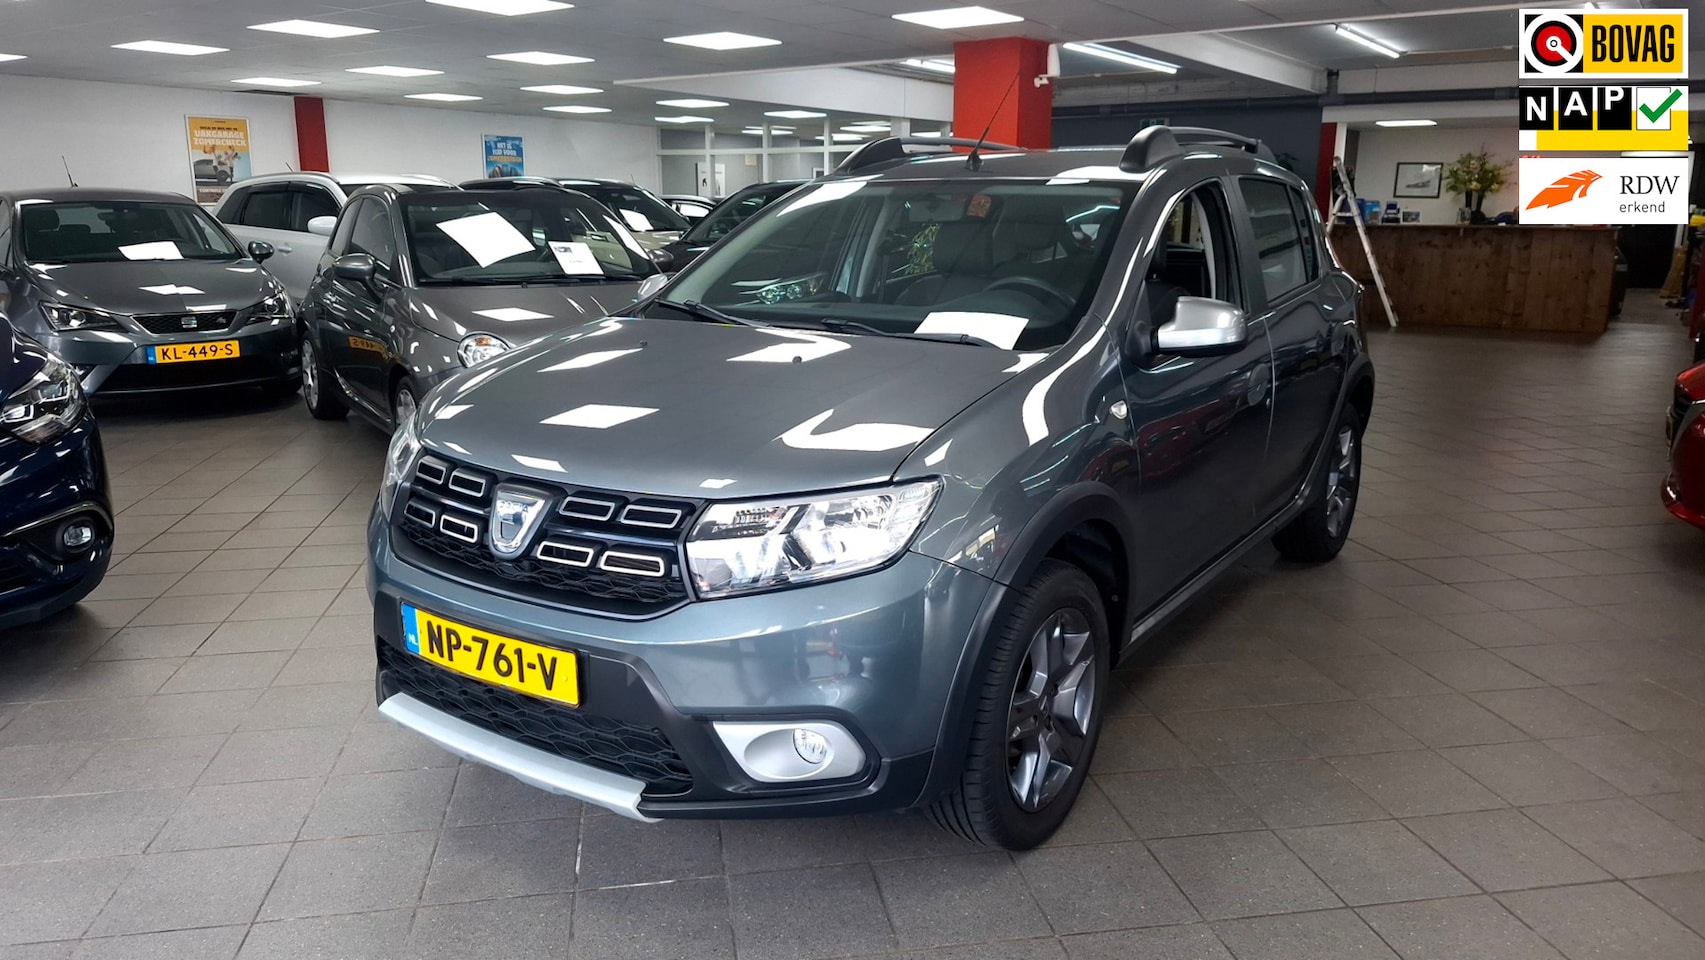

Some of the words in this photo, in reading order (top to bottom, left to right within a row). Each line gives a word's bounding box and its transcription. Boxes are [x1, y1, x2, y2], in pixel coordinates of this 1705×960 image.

[194, 130, 244, 138] VAKGARAGE
[194, 138, 246, 146] ZOMERCHECK
[161, 343, 234, 361] KL-449-S
[426, 620, 557, 691] NP-761-V
